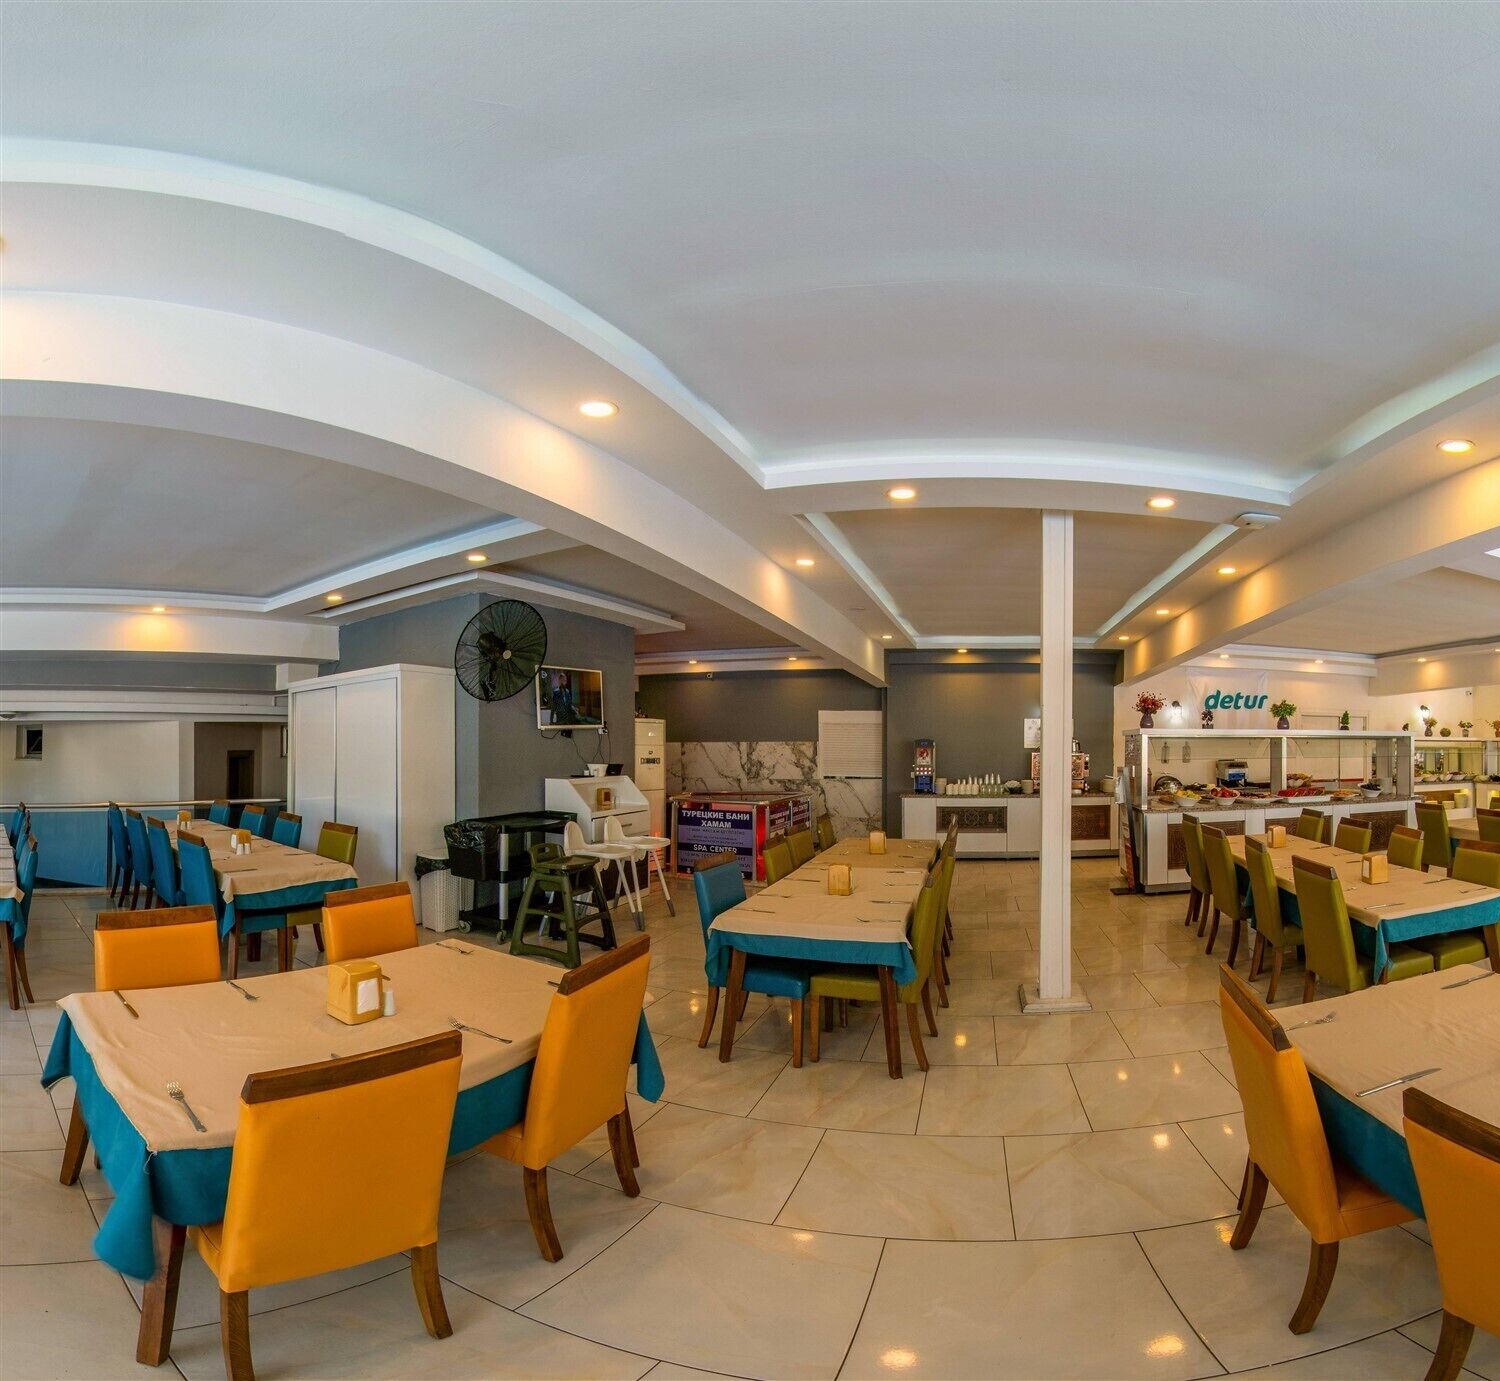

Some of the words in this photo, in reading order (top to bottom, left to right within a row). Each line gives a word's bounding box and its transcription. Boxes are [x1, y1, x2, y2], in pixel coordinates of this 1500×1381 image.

[1204, 689, 1268, 710] detur
[682, 810, 724, 819] ТУРЕЦКИЕ
[701, 820, 731, 828] ХАМАМ
[693, 844, 708, 852] SPA
